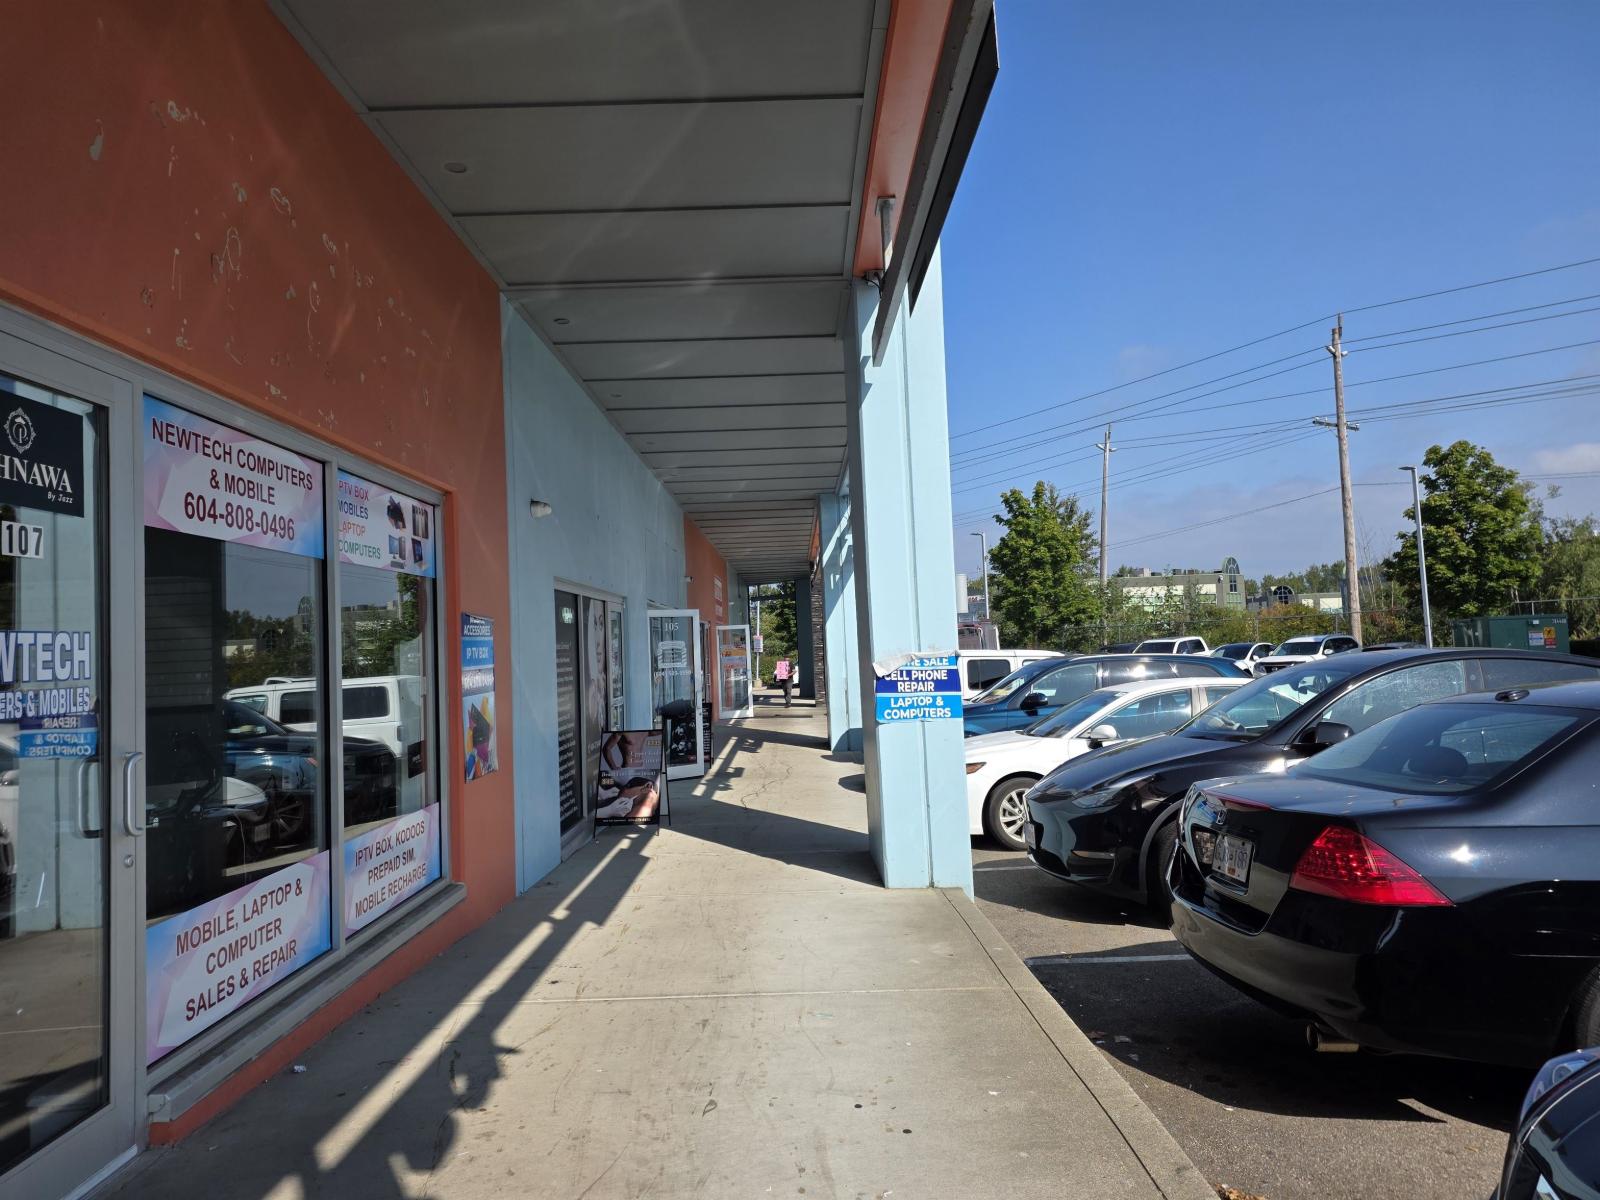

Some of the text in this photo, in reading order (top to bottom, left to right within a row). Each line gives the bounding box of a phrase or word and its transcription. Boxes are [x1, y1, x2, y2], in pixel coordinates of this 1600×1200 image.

[152, 417, 313, 490] NEWTECH COMPUTERS
[210, 468, 275, 505] & MOBILE
[354, 486, 369, 501] BOX
[184, 491, 295, 541] 604-808-0496
[6, 524, 43, 556] 107
[463, 625, 491, 636] ACCESSORIES
[664, 622, 679, 631] 105
[897, 681, 935, 693] REPAIR
[911, 669, 948, 681] PHONE
[26, 690, 36, 718] &
[39, 687, 90, 717] MOBILES
[884, 707, 952, 719] COMPUTERS
[890, 695, 944, 708] LAPTOP &
[355, 844, 374, 867] IPTV
[368, 855, 400, 886] PREPAID
[355, 862, 426, 919] MOBILE RECHARGE
[176, 878, 303, 957] MOBILE, LAPTOP &
[206, 917, 282, 975] COMPUTER
[185, 938, 297, 1022] SALES & REPAIR
